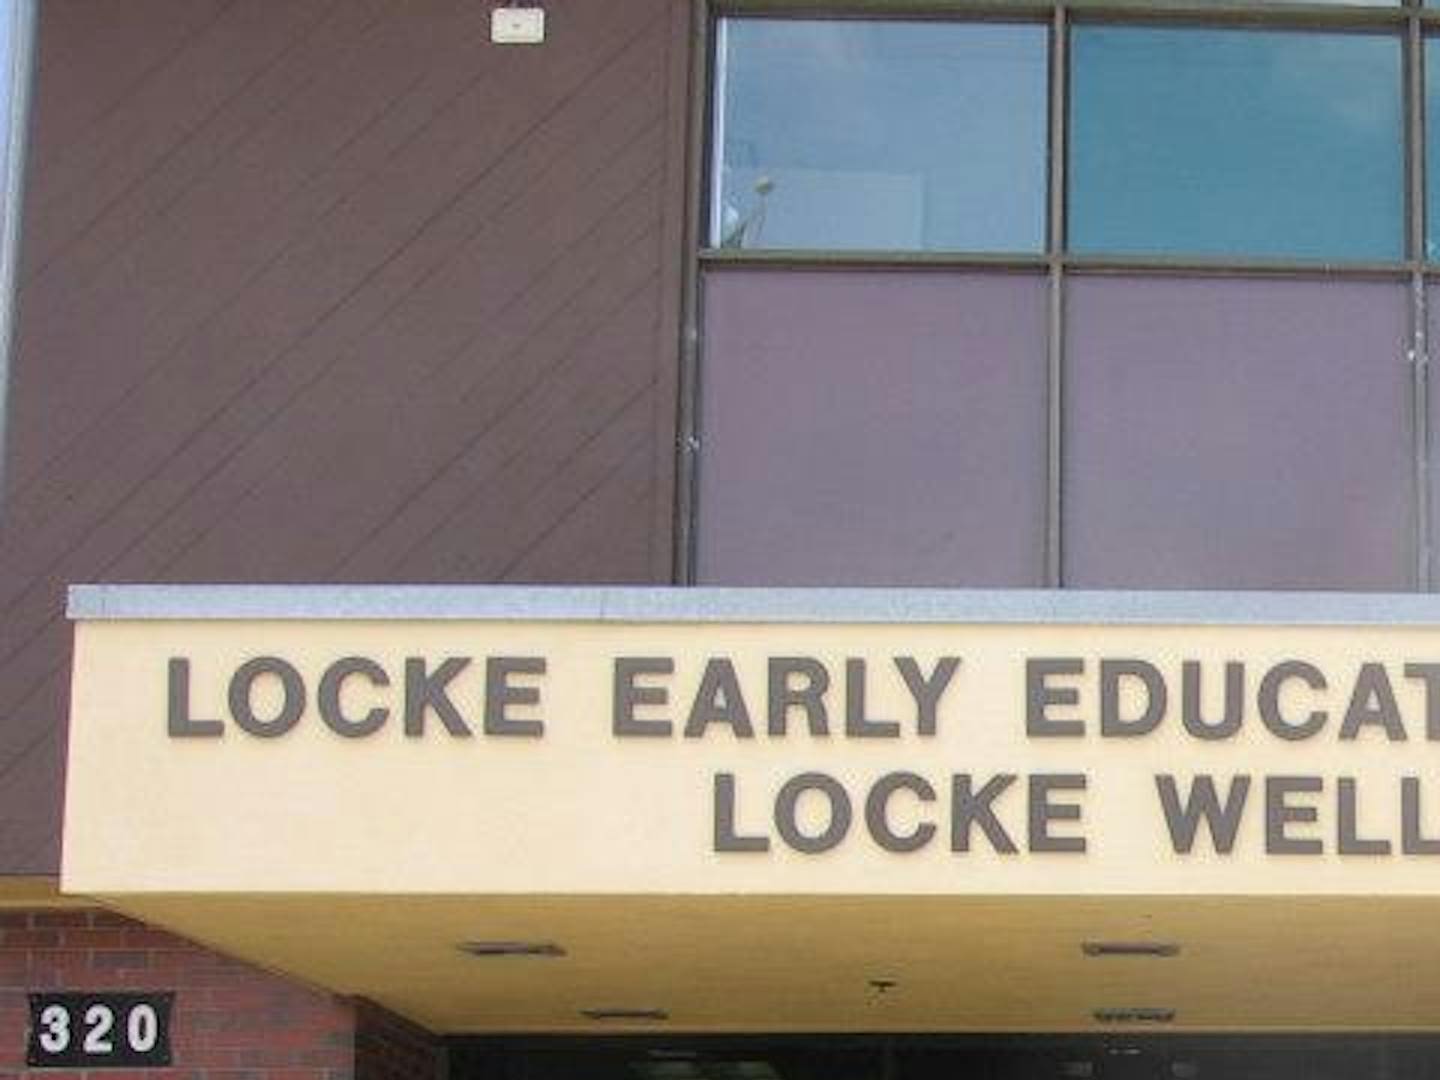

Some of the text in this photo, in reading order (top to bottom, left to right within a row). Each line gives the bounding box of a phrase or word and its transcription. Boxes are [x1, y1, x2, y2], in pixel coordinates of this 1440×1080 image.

[167, 656, 547, 739] LOCKE
[612, 657, 961, 739] EARLY
[713, 772, 1087, 855] LOCKE
[39, 1003, 158, 1053] 320
